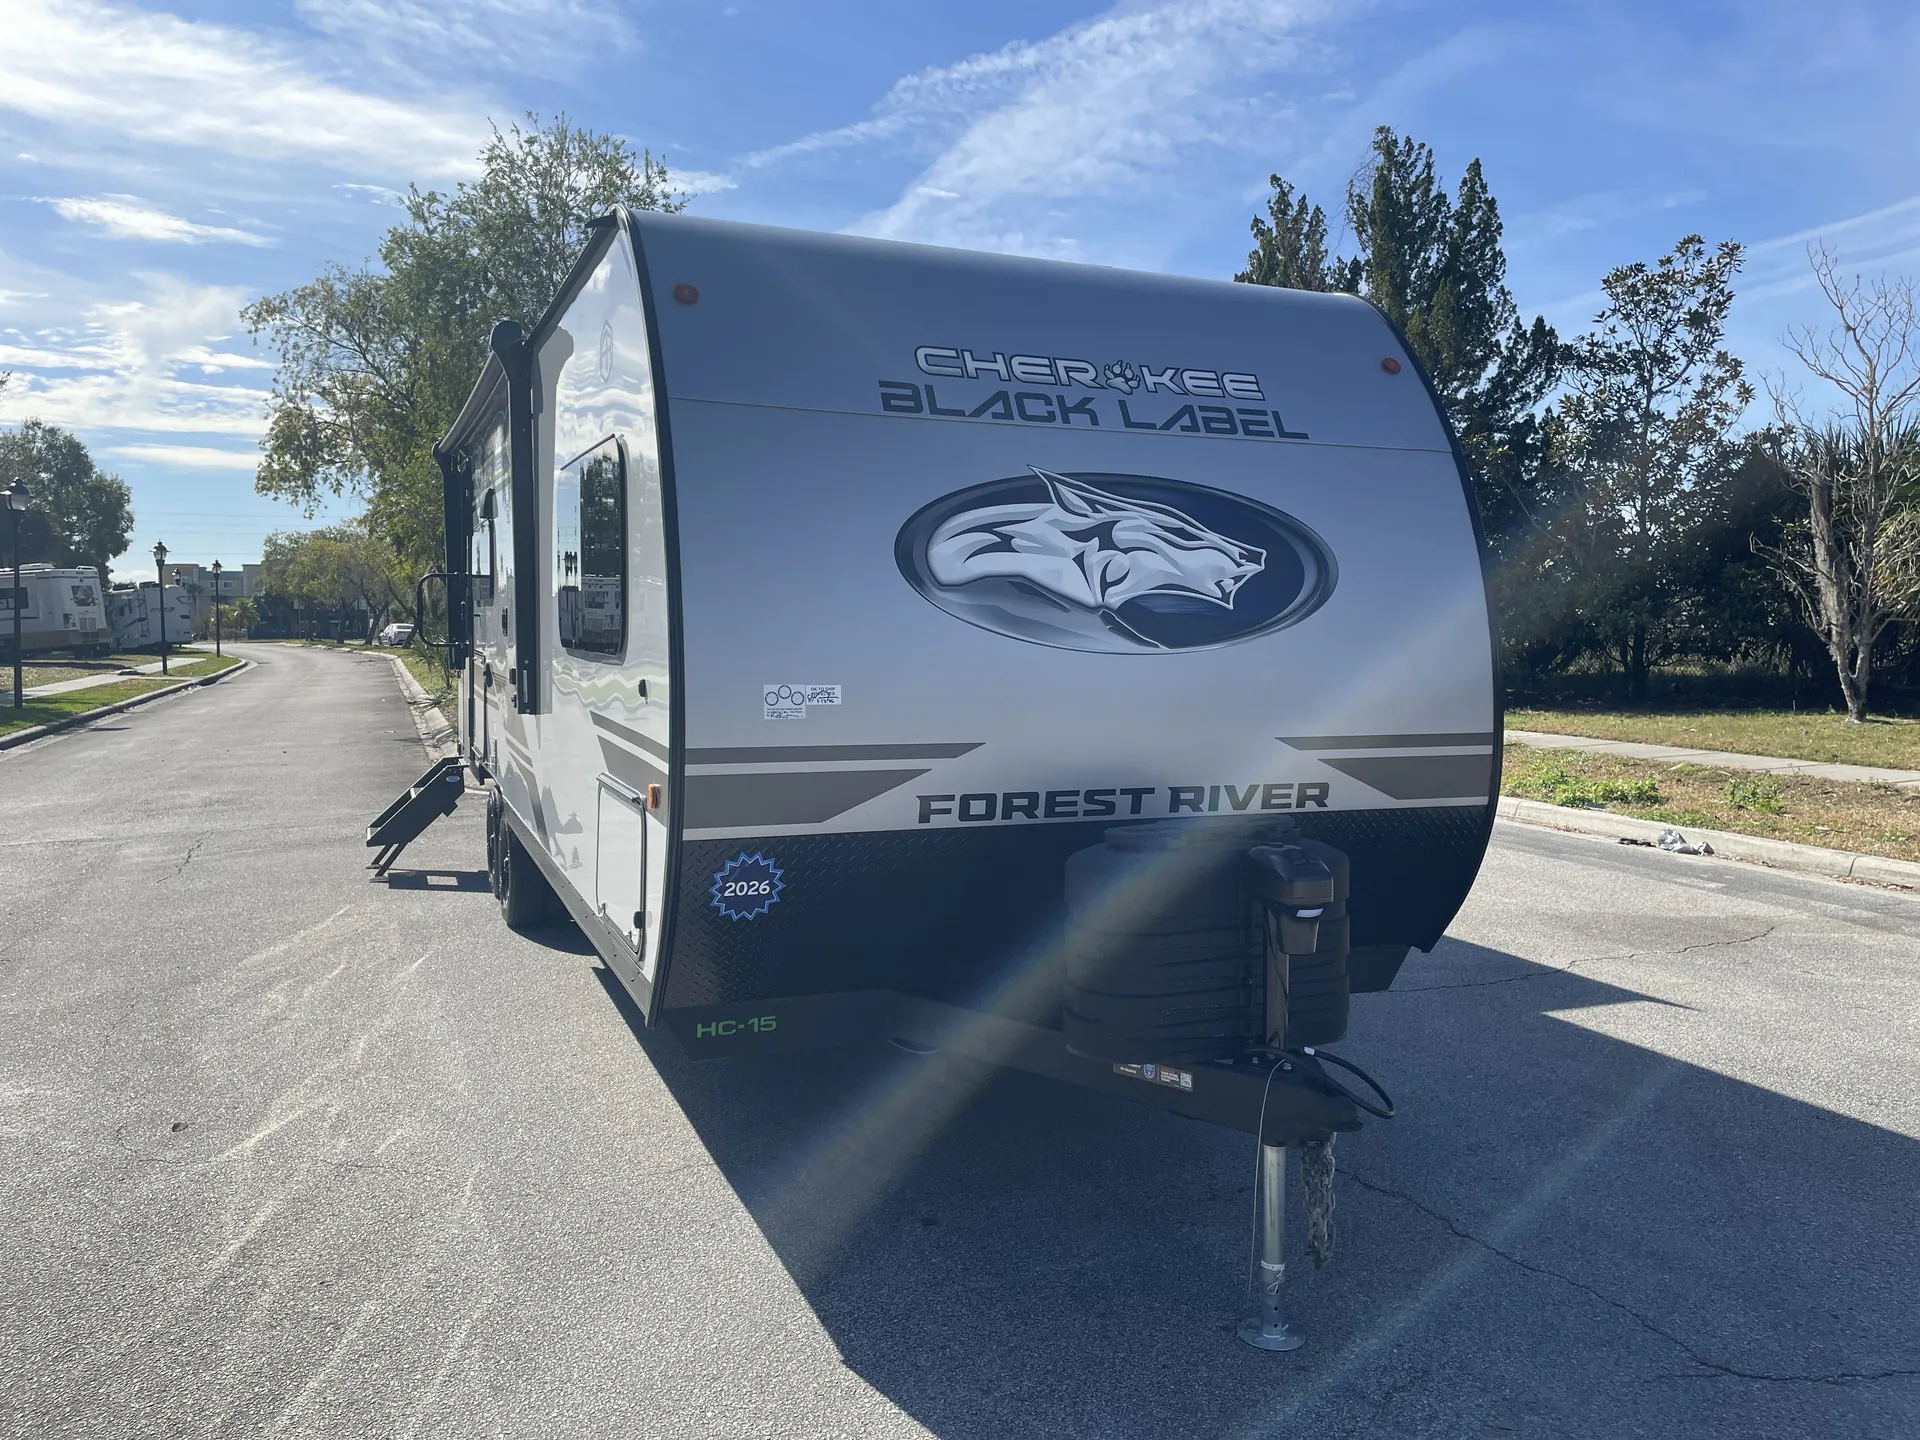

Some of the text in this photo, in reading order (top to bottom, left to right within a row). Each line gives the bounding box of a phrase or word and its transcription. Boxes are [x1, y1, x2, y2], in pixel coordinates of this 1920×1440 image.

[878, 380, 1309, 440] BLACK LABEL
[916, 782, 1330, 824] FOREST RIVER
[723, 880, 770, 897] 2026
[696, 1015, 777, 1039] HC-15
